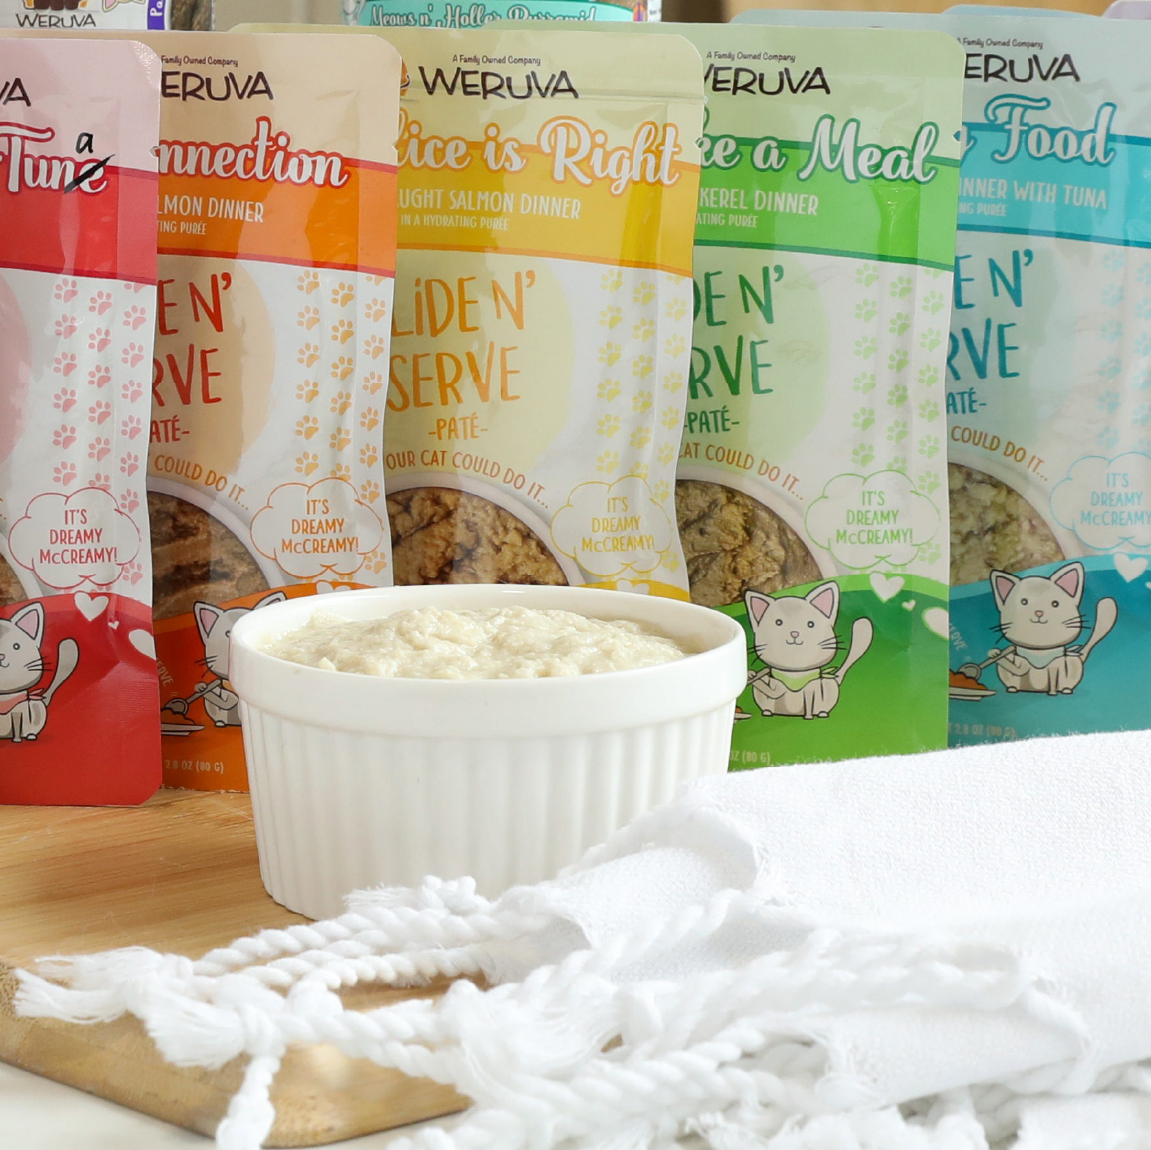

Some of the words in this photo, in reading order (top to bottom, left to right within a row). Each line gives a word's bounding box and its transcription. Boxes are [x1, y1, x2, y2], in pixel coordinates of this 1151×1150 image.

[16, 13, 96, 28] WERUVA
[418, 66, 579, 100] WERUVA
[986, 95, 1116, 165] Food
[484, 125, 526, 171] is
[540, 118, 680, 195] Right
[753, 139, 787, 170] a
[799, 117, 936, 182] Meal
[754, 191, 819, 216] DINNER
[1013, 180, 1057, 203] WITH
[1064, 184, 1107, 210] TUNA
[208, 198, 264, 223] DINNER
[449, 189, 514, 212] SALMON
[520, 194, 581, 219] DINNER
[423, 214, 478, 229] HYDRATING
[387, 341, 521, 412] SERVE
[951, 426, 1000, 451] COULD
[1003, 441, 1027, 463] DO
[421, 450, 446, 466] CAT
[452, 451, 501, 478] COULD
[503, 468, 526, 490] DO
[705, 444, 754, 470] COULD
[758, 460, 781, 482] DO
[154, 454, 203, 481] COULD
[205, 473, 228, 492] DO
[1106, 473, 1129, 488] IT'S
[306, 499, 330, 515] IT'S
[606, 496, 628, 512] IT'S
[862, 491, 885, 506] IT'S
[1091, 491, 1144, 507] DREAMY
[64, 509, 88, 525] IT'S
[591, 516, 641, 533] DREAMY
[846, 510, 899, 526] DREAMY
[291, 518, 345, 535] DREAMY
[49, 528, 103, 545] DREAMY
[281, 537, 359, 554] McCREAMY!
[39, 548, 117, 565] McCREAMY!
